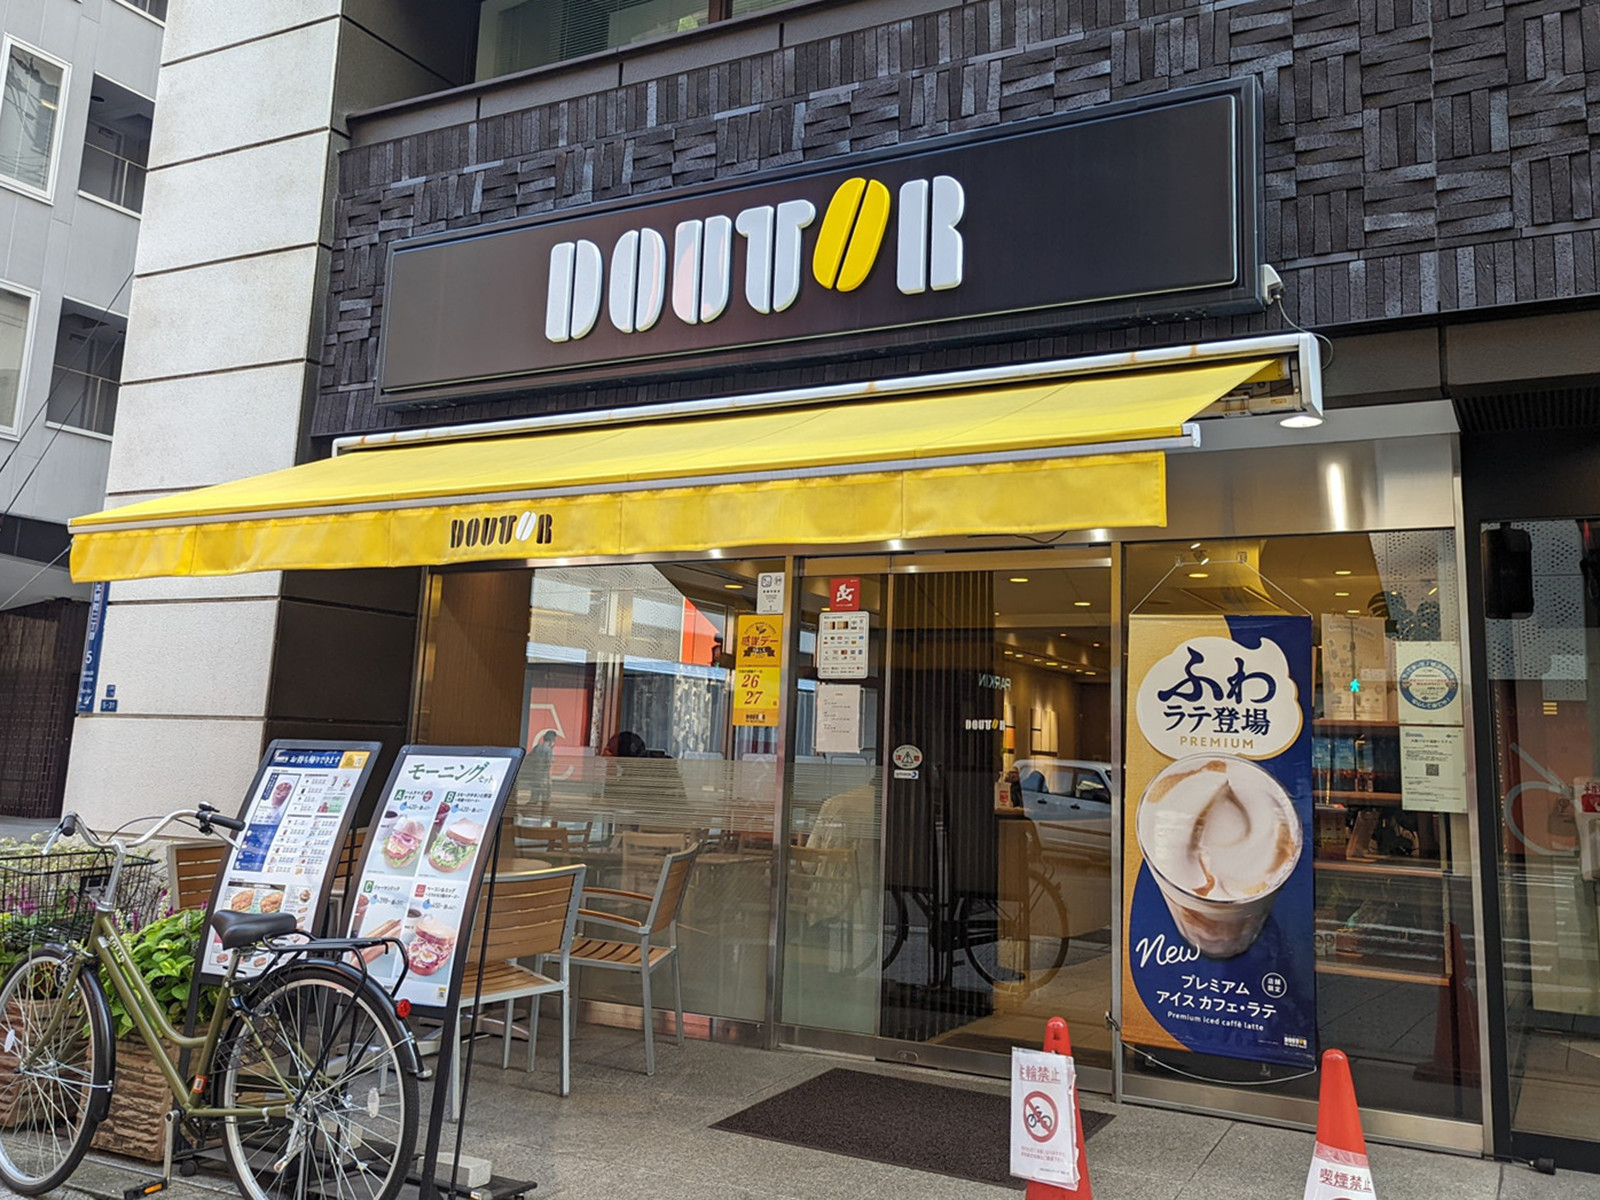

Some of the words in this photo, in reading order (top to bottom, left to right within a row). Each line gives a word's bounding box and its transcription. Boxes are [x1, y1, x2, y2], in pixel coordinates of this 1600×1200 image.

[545, 175, 965, 343] DOUTOR
[450, 511, 553, 548] DOUTOR
[741, 674, 760, 688] 26
[1157, 646, 1277, 704] ふわ
[744, 691, 763, 705] 27
[1163, 705, 1271, 736] ラテ登場
[1180, 736, 1254, 749] PREMIUM
[408, 761, 490, 783] モーニング
[1136, 933, 1201, 968] New
[1181, 974, 1250, 996] プレミアム
[1156, 990, 1195, 1008] アイス
[1199, 995, 1277, 1019] カフェ・ラテ
[1167, 1010, 1202, 1022] Premium
[1203, 1015, 1220, 1026] iced
[1243, 1021, 1264, 1031] latte
[1320, 1167, 1372, 1192] 喫煙禁止
